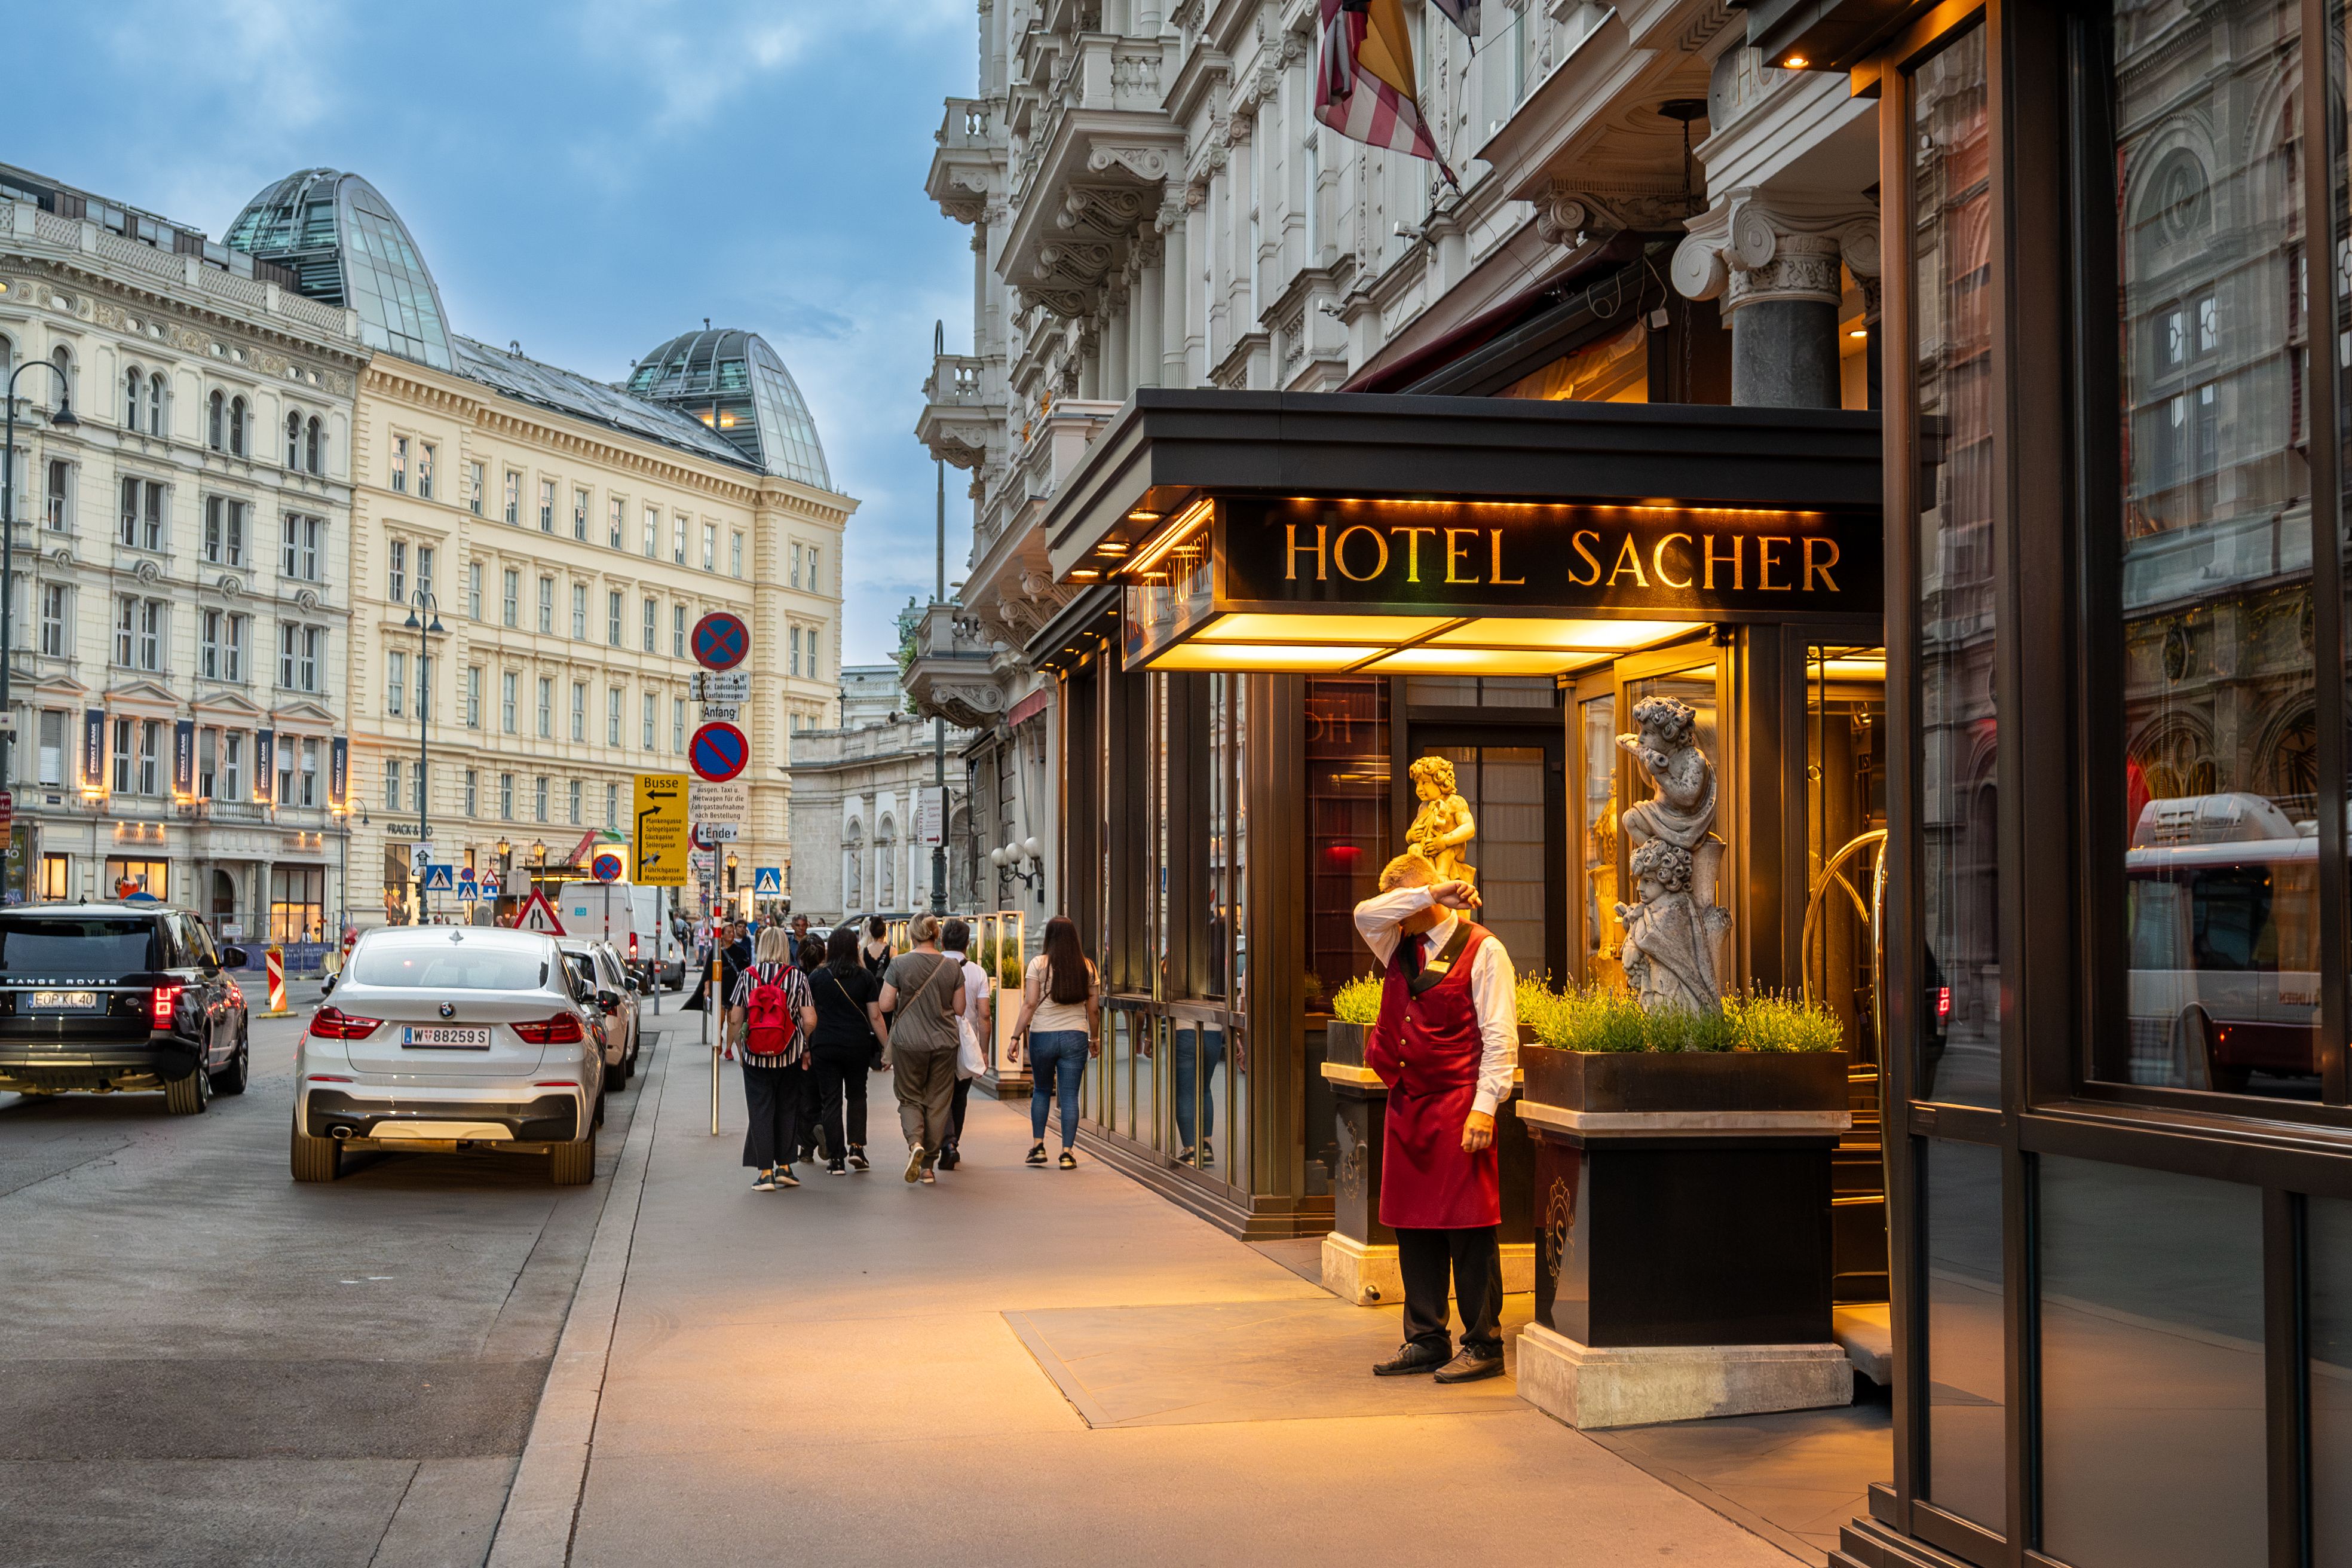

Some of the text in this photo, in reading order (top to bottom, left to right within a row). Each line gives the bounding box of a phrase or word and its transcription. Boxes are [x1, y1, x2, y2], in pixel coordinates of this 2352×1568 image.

[1285, 523, 1841, 592] HOTEL SACHER
[1129, 531, 1209, 641] HOTEL SACHER
[704, 706, 735, 719] Anfang
[644, 777, 679, 788] Busse
[387, 823, 411, 835] FRACK
[414, 825, 419, 836] &
[706, 827, 730, 838] Ende
[645, 866, 680, 875] Führichgasse
[414, 1029, 423, 1042] W
[433, 1030, 474, 1043] 88259
[1556, 1219, 1563, 1255] S
